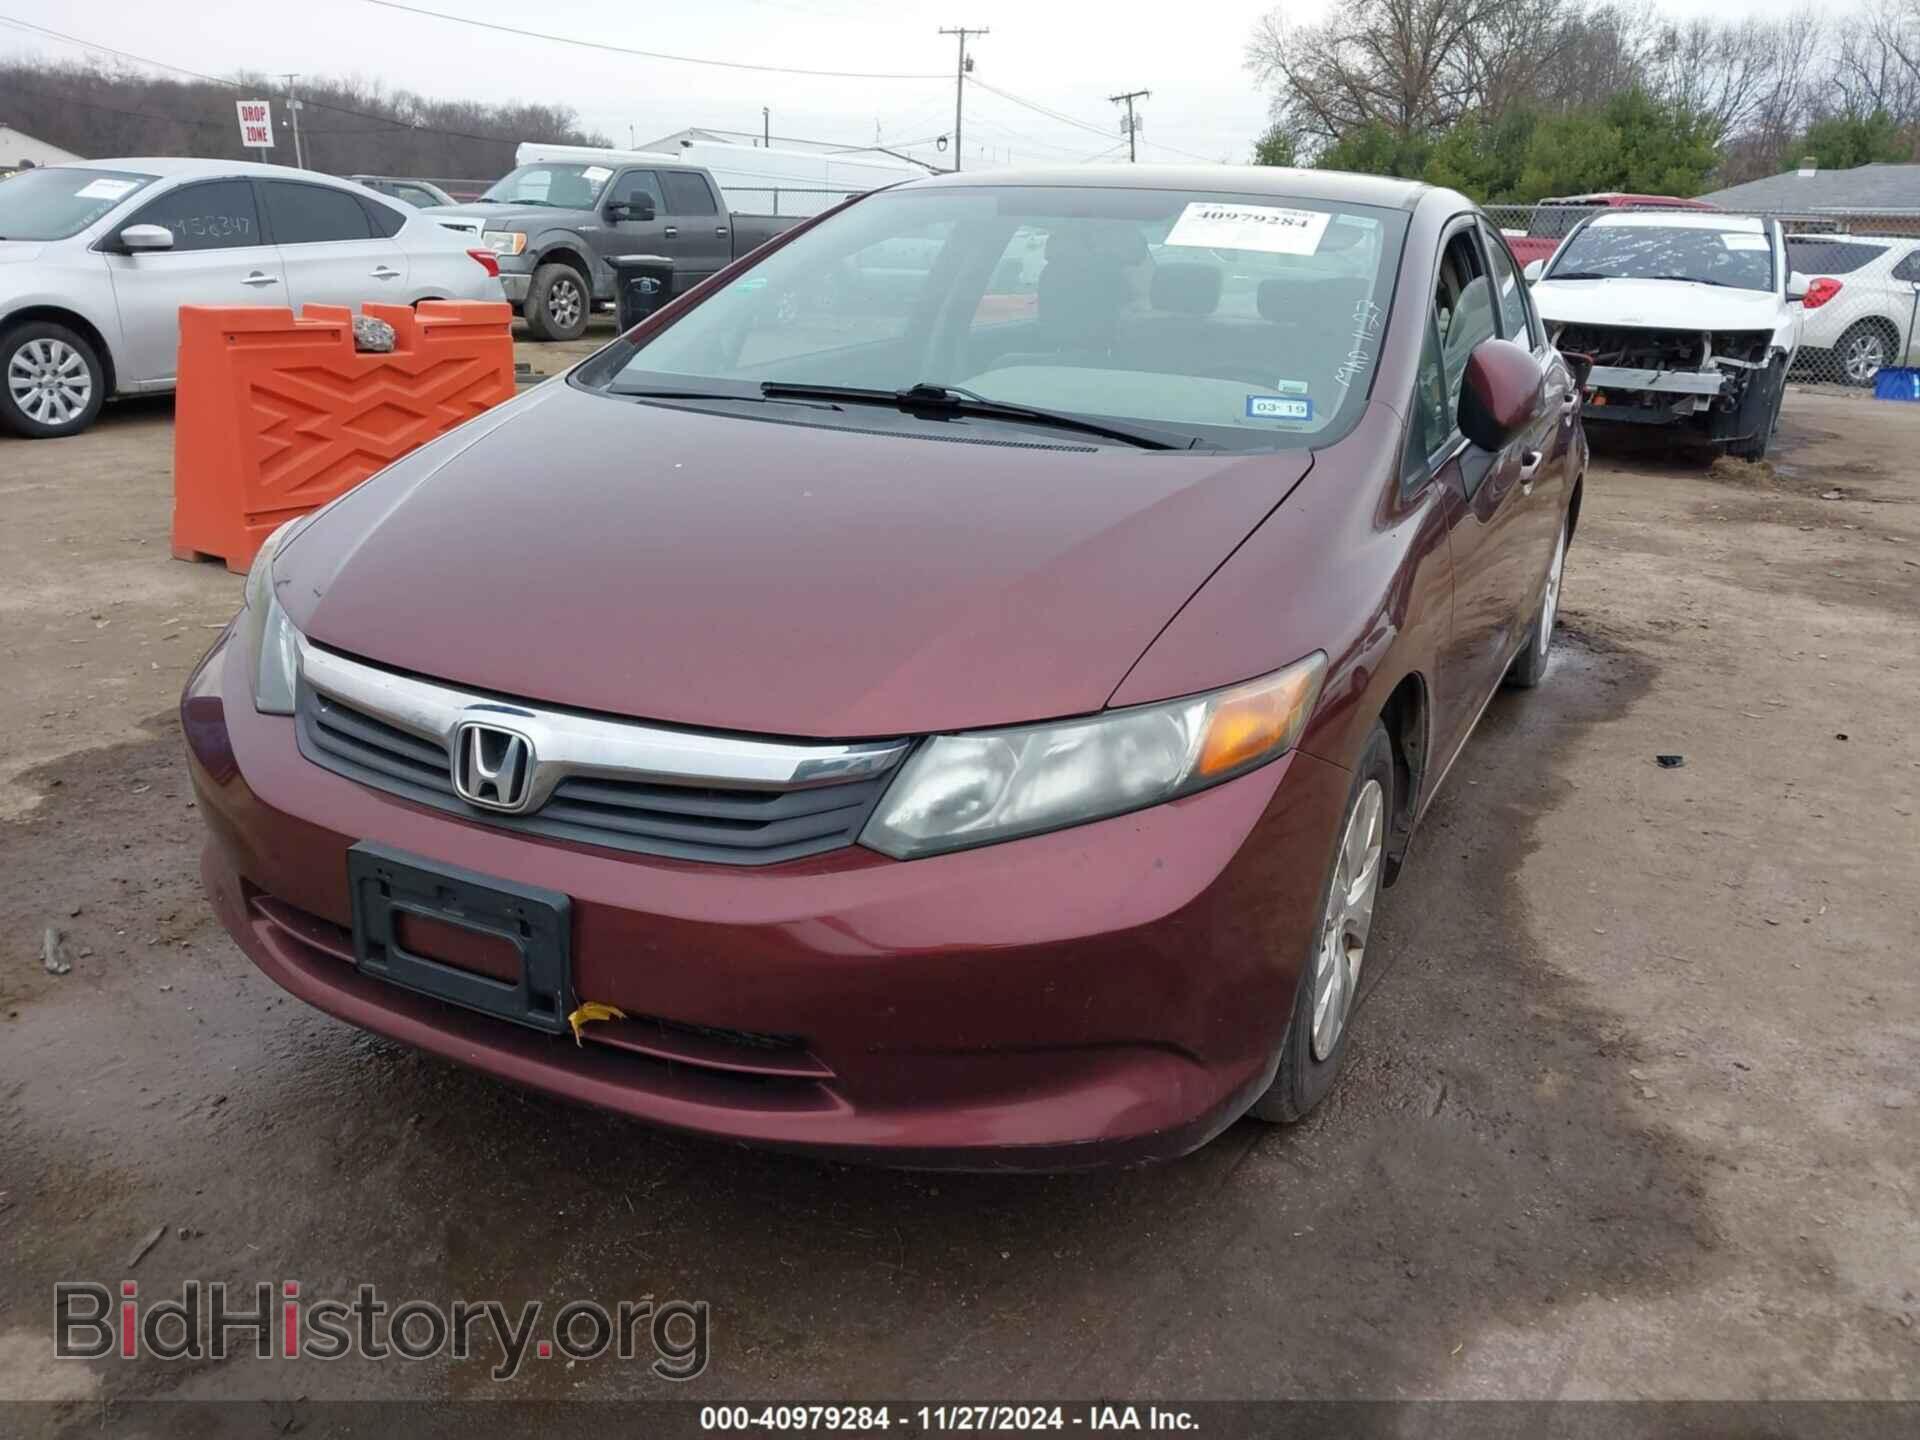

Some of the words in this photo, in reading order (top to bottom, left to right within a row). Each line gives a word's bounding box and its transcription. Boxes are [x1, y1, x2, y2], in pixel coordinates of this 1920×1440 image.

[241, 105, 266, 122] DROP
[246, 126, 268, 142] ZONE
[1195, 210, 1309, 228] 40979284
